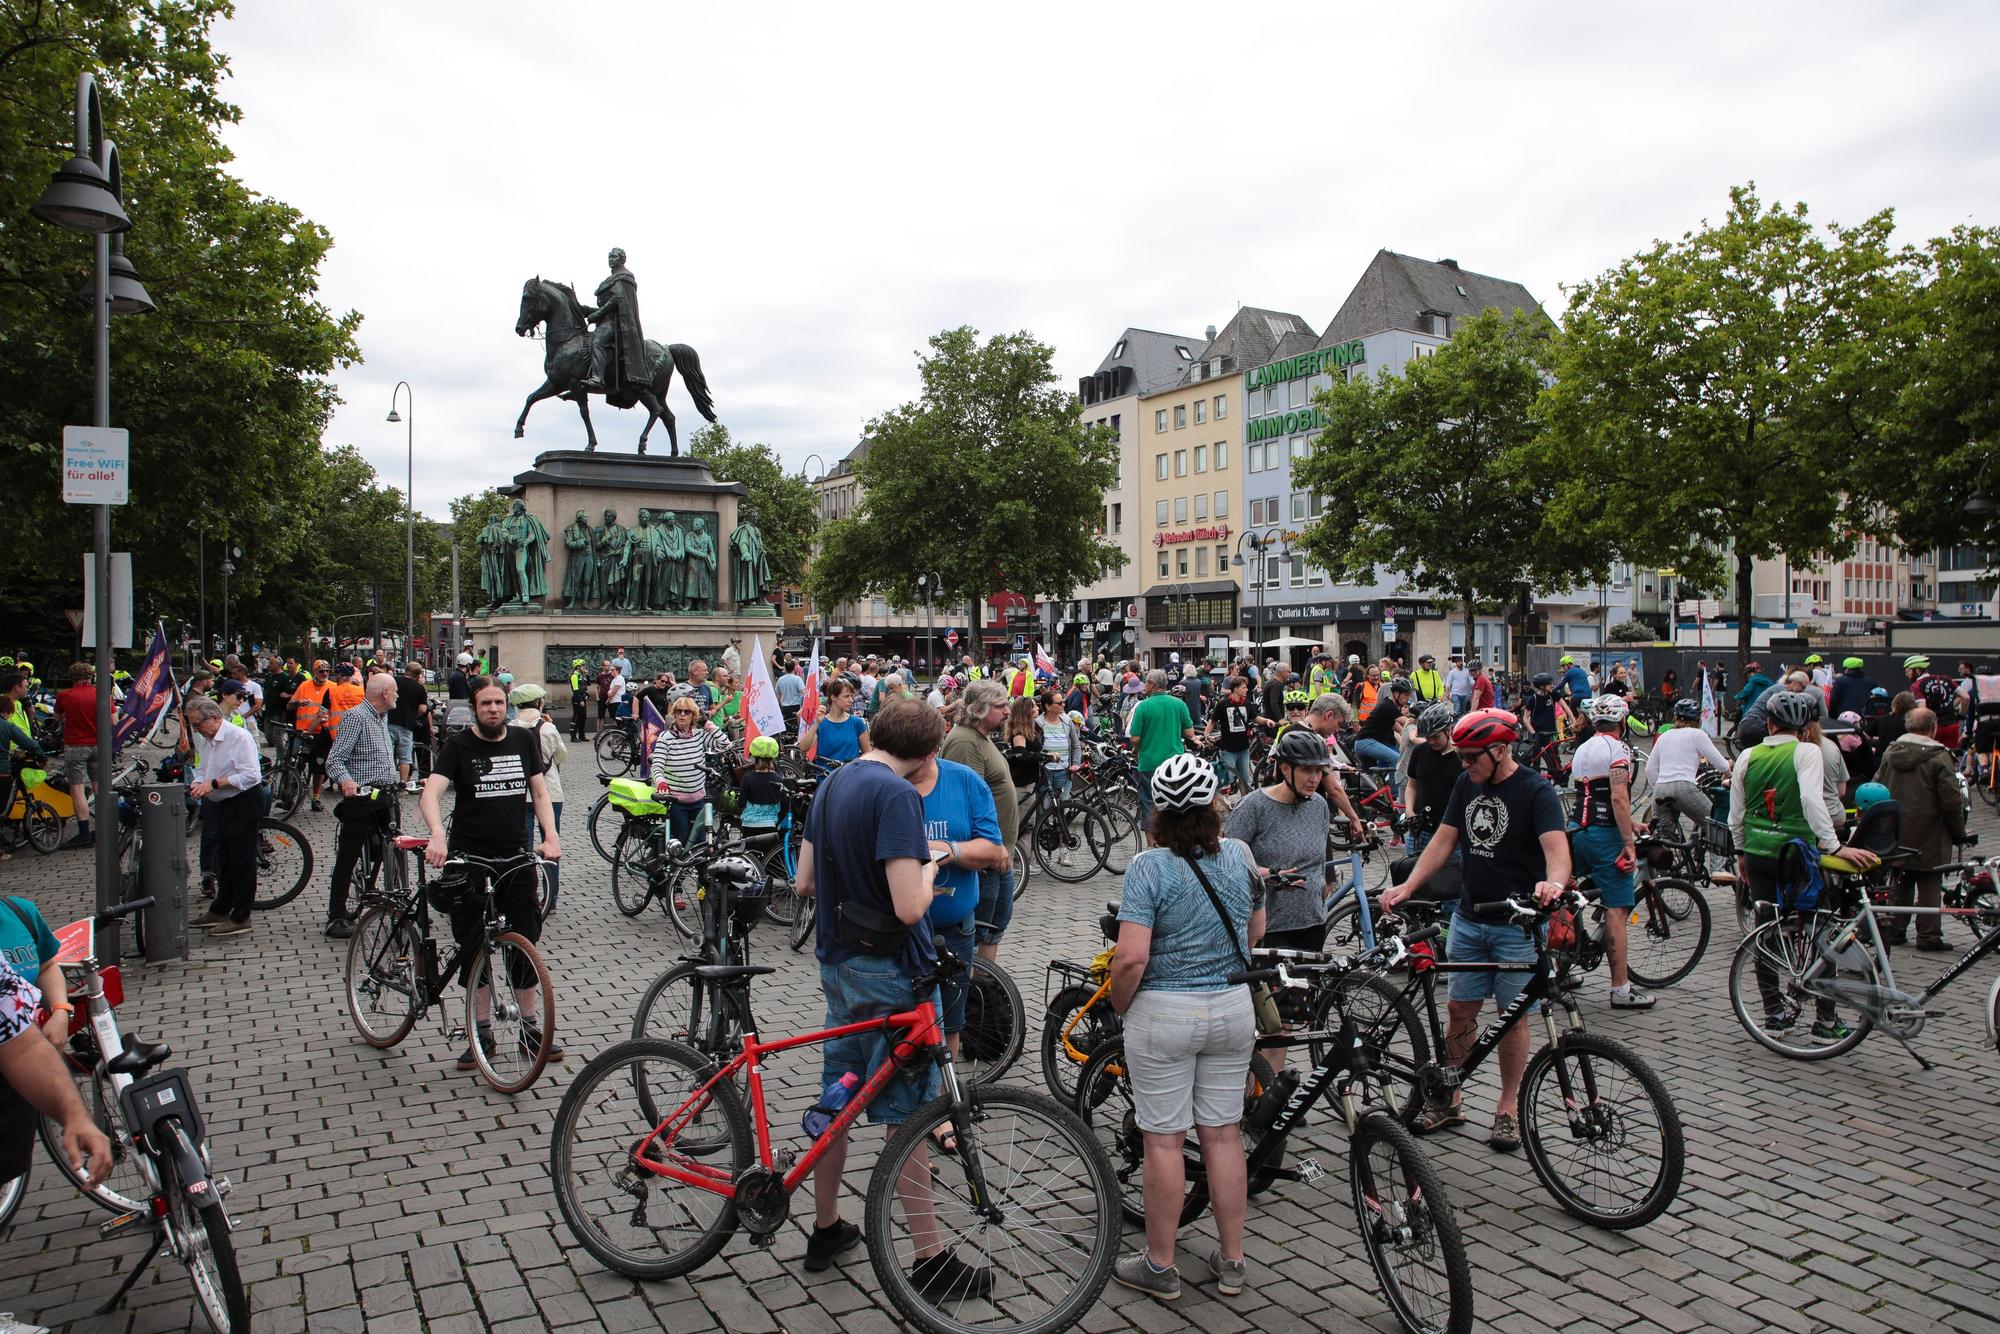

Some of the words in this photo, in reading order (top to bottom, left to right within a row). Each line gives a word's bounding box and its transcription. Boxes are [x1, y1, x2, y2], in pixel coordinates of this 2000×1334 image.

[1245, 339, 1365, 391] LAMMERTING
[67, 458, 94, 468] Free
[98, 459, 125, 469] WiFi
[67, 470, 84, 479] für
[88, 471, 115, 481] alle!
[1277, 608, 1301, 619] Trattoria
[1303, 606, 1330, 617] L'Ancora
[1394, 606, 1414, 616] rattoria
[1095, 622, 1110, 632] ART
[474, 783, 507, 792] TRUCK
[509, 780, 527, 789] YOU
[1480, 993, 1528, 1045] CANYON
[1272, 1065, 1329, 1131] CANYON
